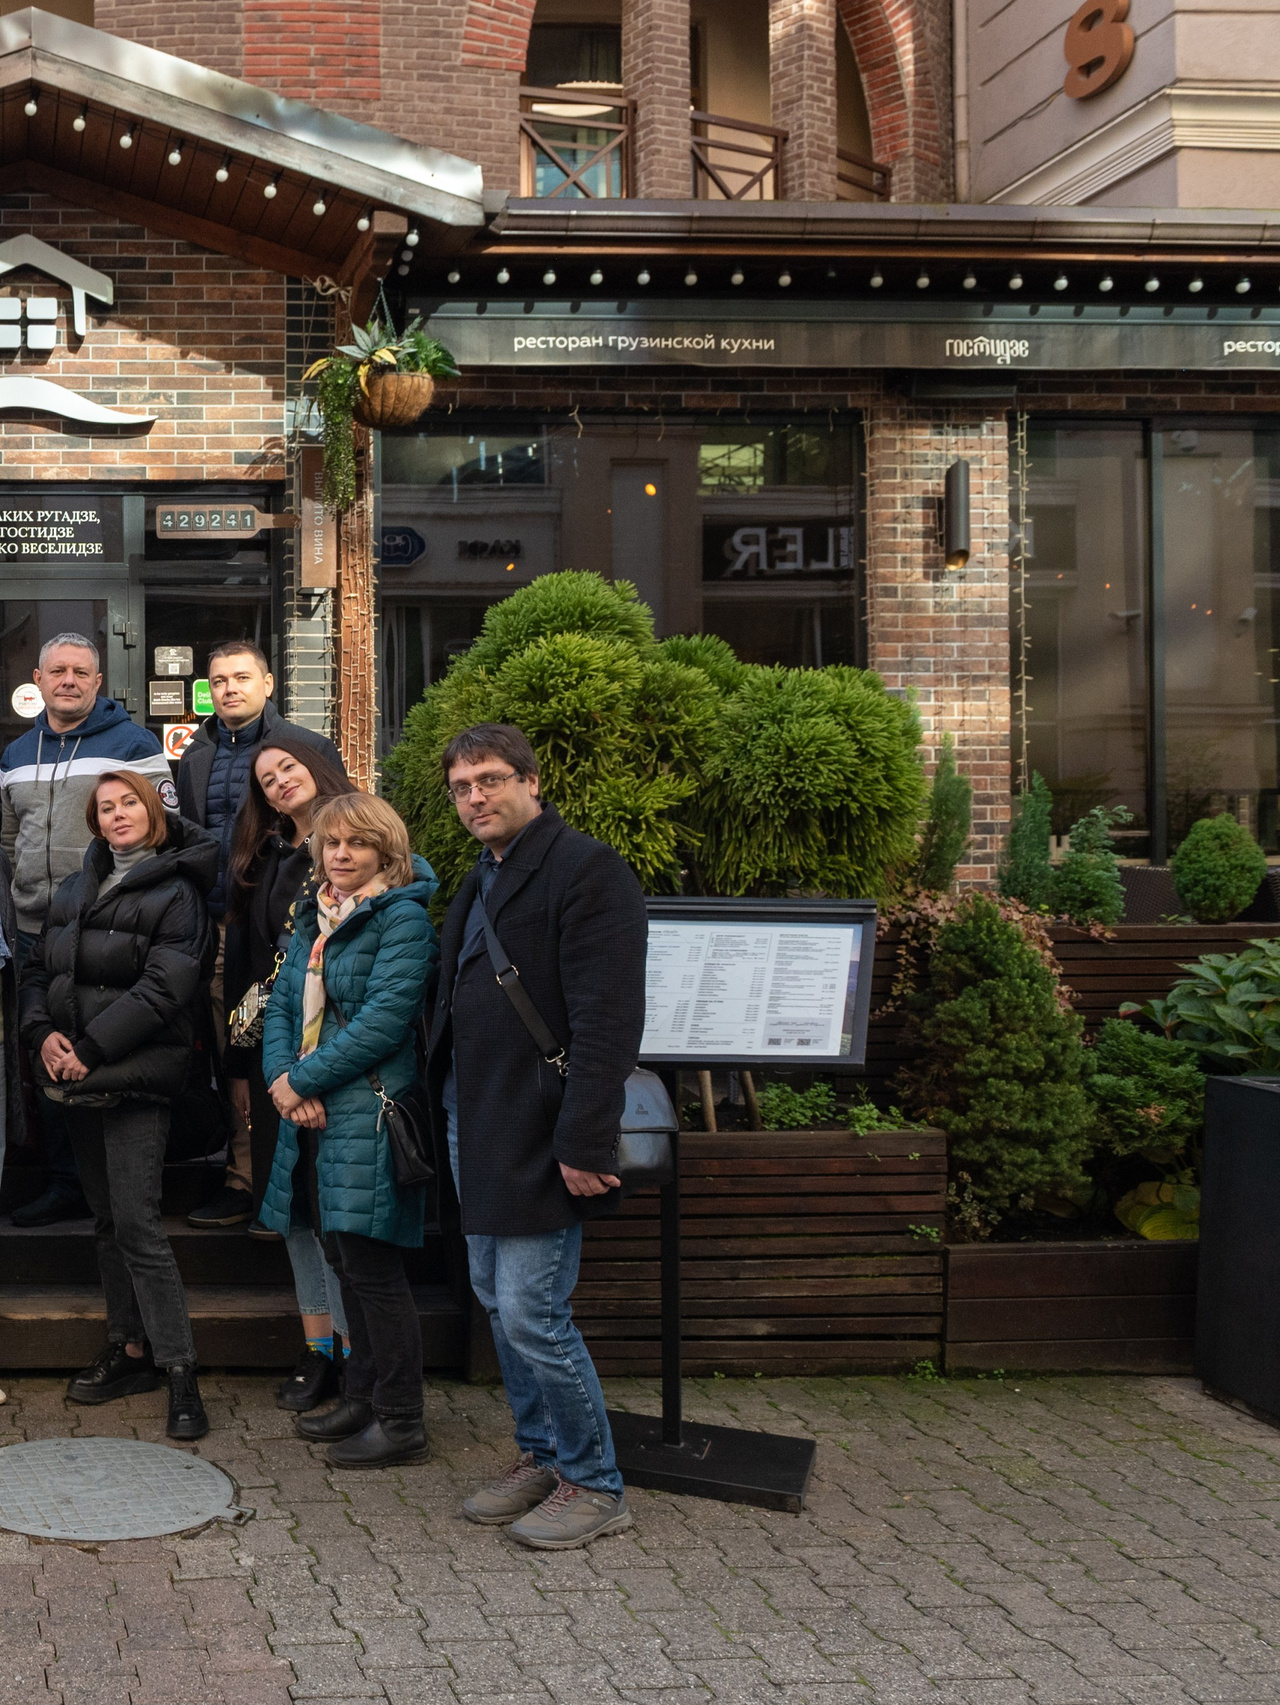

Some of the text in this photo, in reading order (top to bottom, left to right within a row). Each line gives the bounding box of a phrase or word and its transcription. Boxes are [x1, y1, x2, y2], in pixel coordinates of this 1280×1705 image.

[514, 333, 775, 353] ресторан грузинской кухни
[37, 510, 101, 524] РУГАДЗЕ,
[0, 527, 75, 540] ГОСТИДЗЕ
[21, 543, 103, 557] ВЕСЕЛИДЗЕ
[314, 529, 323, 565] ВИНА
